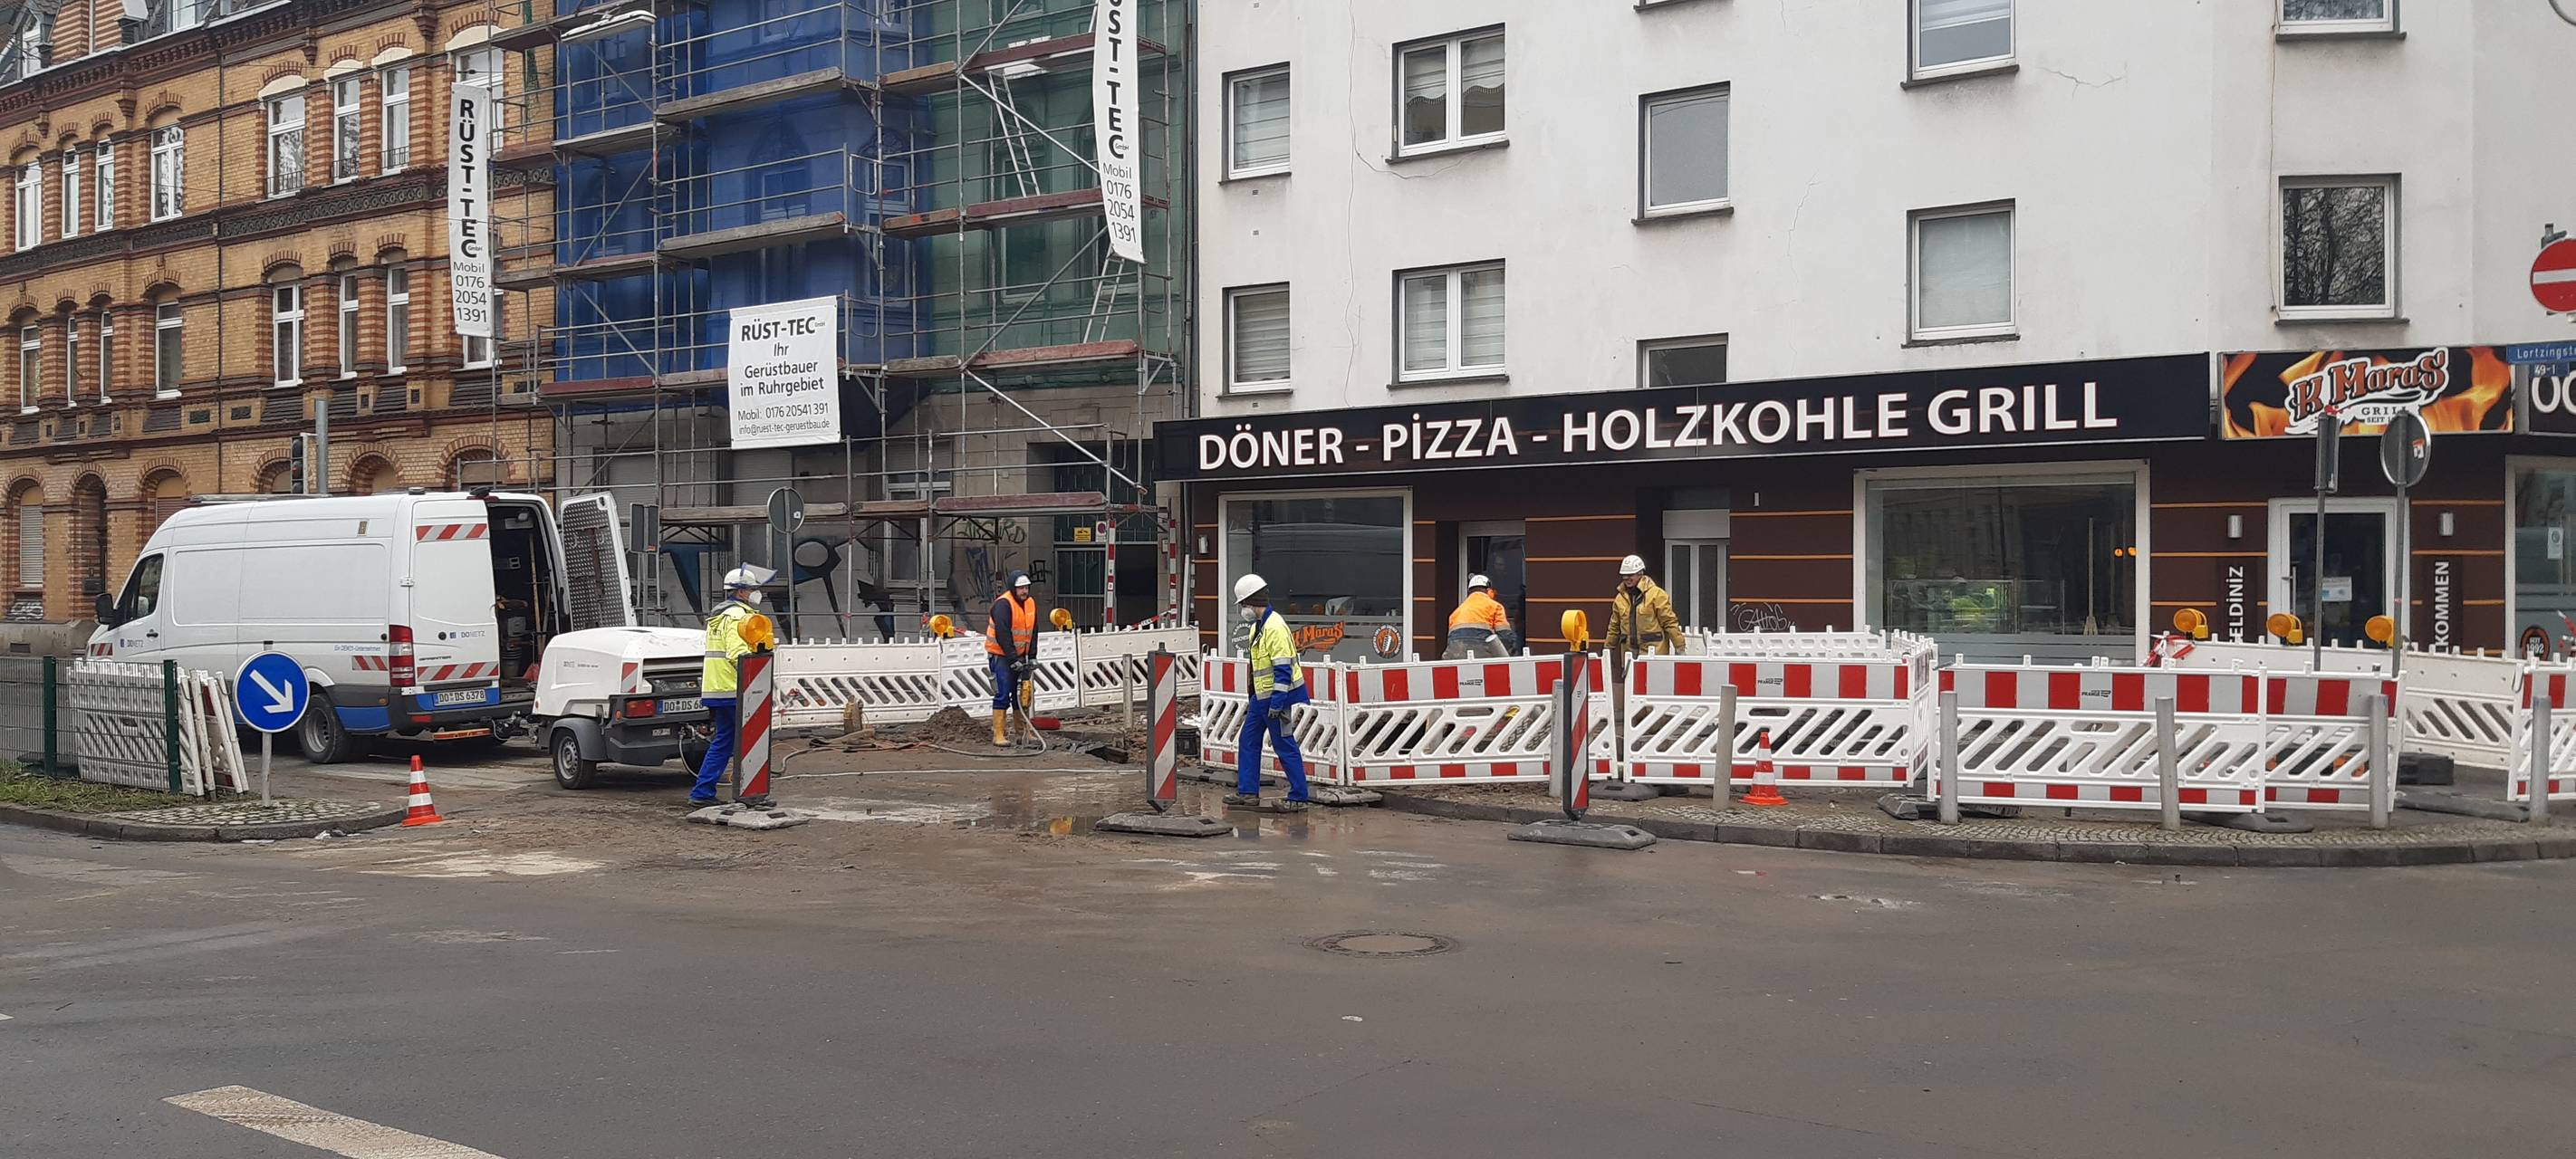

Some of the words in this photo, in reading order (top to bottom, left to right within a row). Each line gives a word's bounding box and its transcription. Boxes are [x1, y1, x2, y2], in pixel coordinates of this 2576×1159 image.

[459, 98, 477, 259] RÜST-TEC
[1103, 163, 1132, 179] Mobil
[1107, 180, 1132, 199] 0176
[1108, 198, 1135, 221] 2054
[1111, 222, 1137, 244] 1391
[453, 262, 485, 273] Mobil
[456, 275, 485, 289] 0176
[455, 290, 487, 305] 2054
[457, 307, 487, 322] 1391
[741, 317, 816, 341] RÜST-TEC
[774, 342, 790, 357] Ihr
[745, 361, 819, 378] Gerüstbauer
[740, 383, 754, 397] im
[758, 377, 825, 397] Ruhrgebiet
[737, 408, 763, 421] Mobil:
[1199, 424, 1344, 470] DÖNER
[1562, 392, 1909, 453] HOLZKOHLE
[1927, 381, 2119, 436] GRILL
[439, 692, 448, 702] DO
[455, 691, 465, 701] DS
[466, 690, 485, 700] 6378
[664, 702, 675, 712] DO
[681, 701, 692, 710] DS
